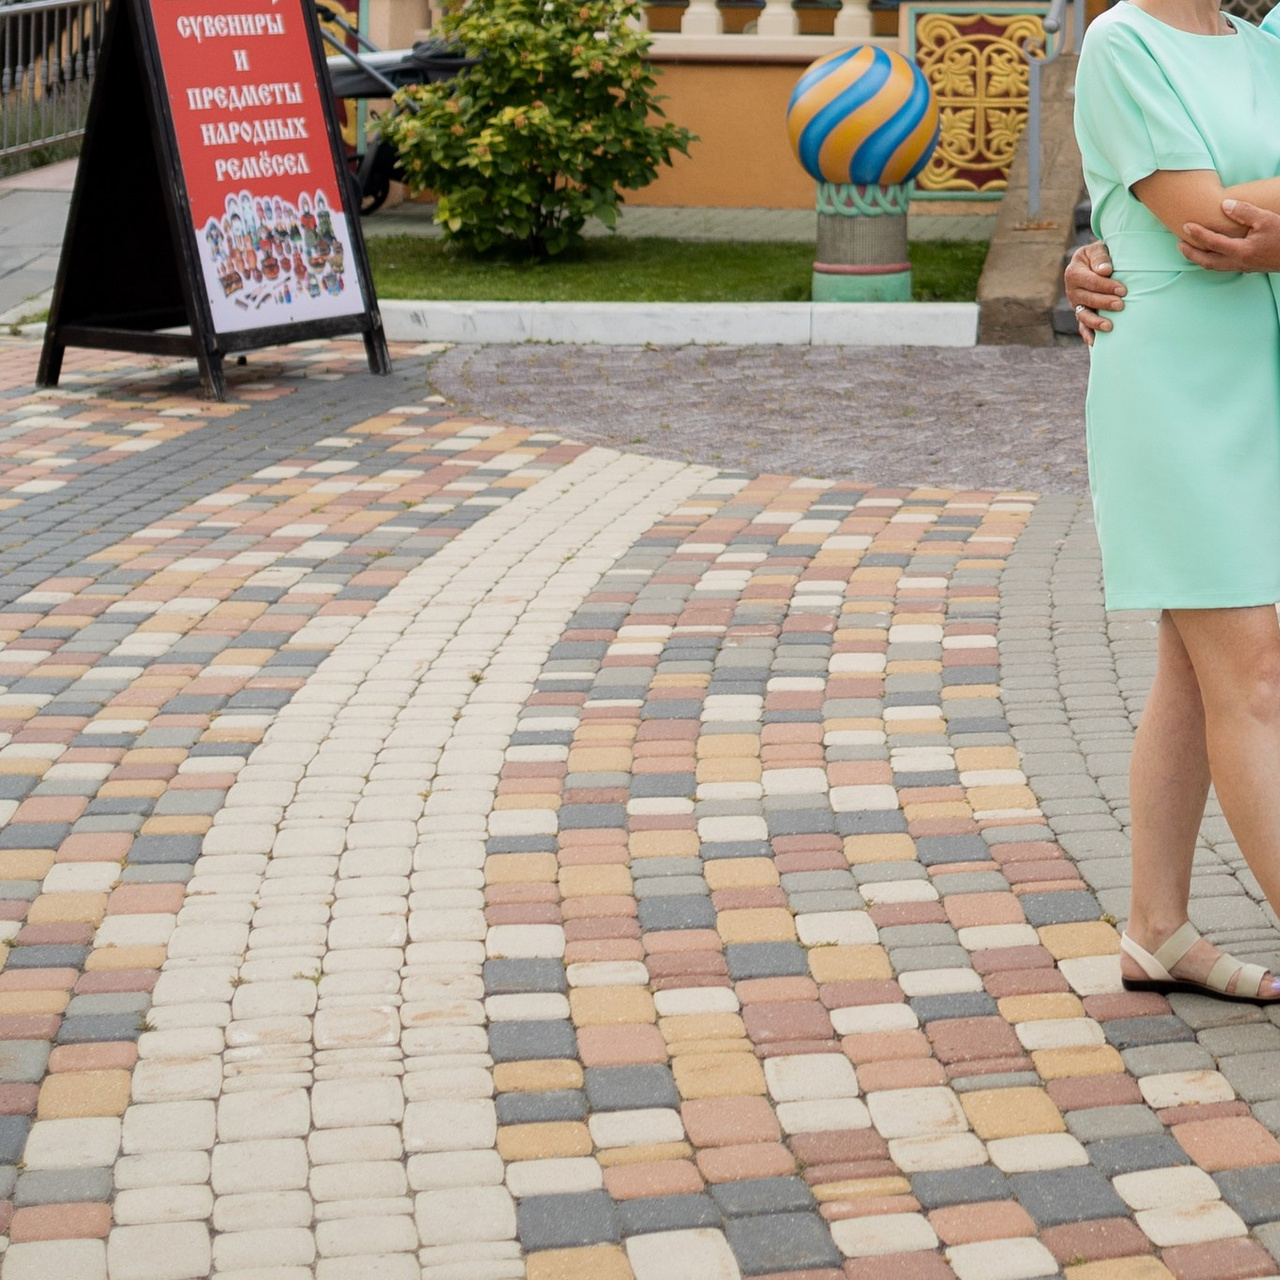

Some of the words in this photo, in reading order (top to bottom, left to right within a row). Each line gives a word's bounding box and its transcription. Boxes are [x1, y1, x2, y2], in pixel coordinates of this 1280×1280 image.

[176, 13, 285, 43] СУВЕНИРЫ
[233, 50, 249, 71] И
[186, 82, 302, 111] ПРЕДМЕТЫ
[200, 117, 308, 145] НАРОДНЫХ
[215, 151, 309, 181] РЕМЁСЕЛ
